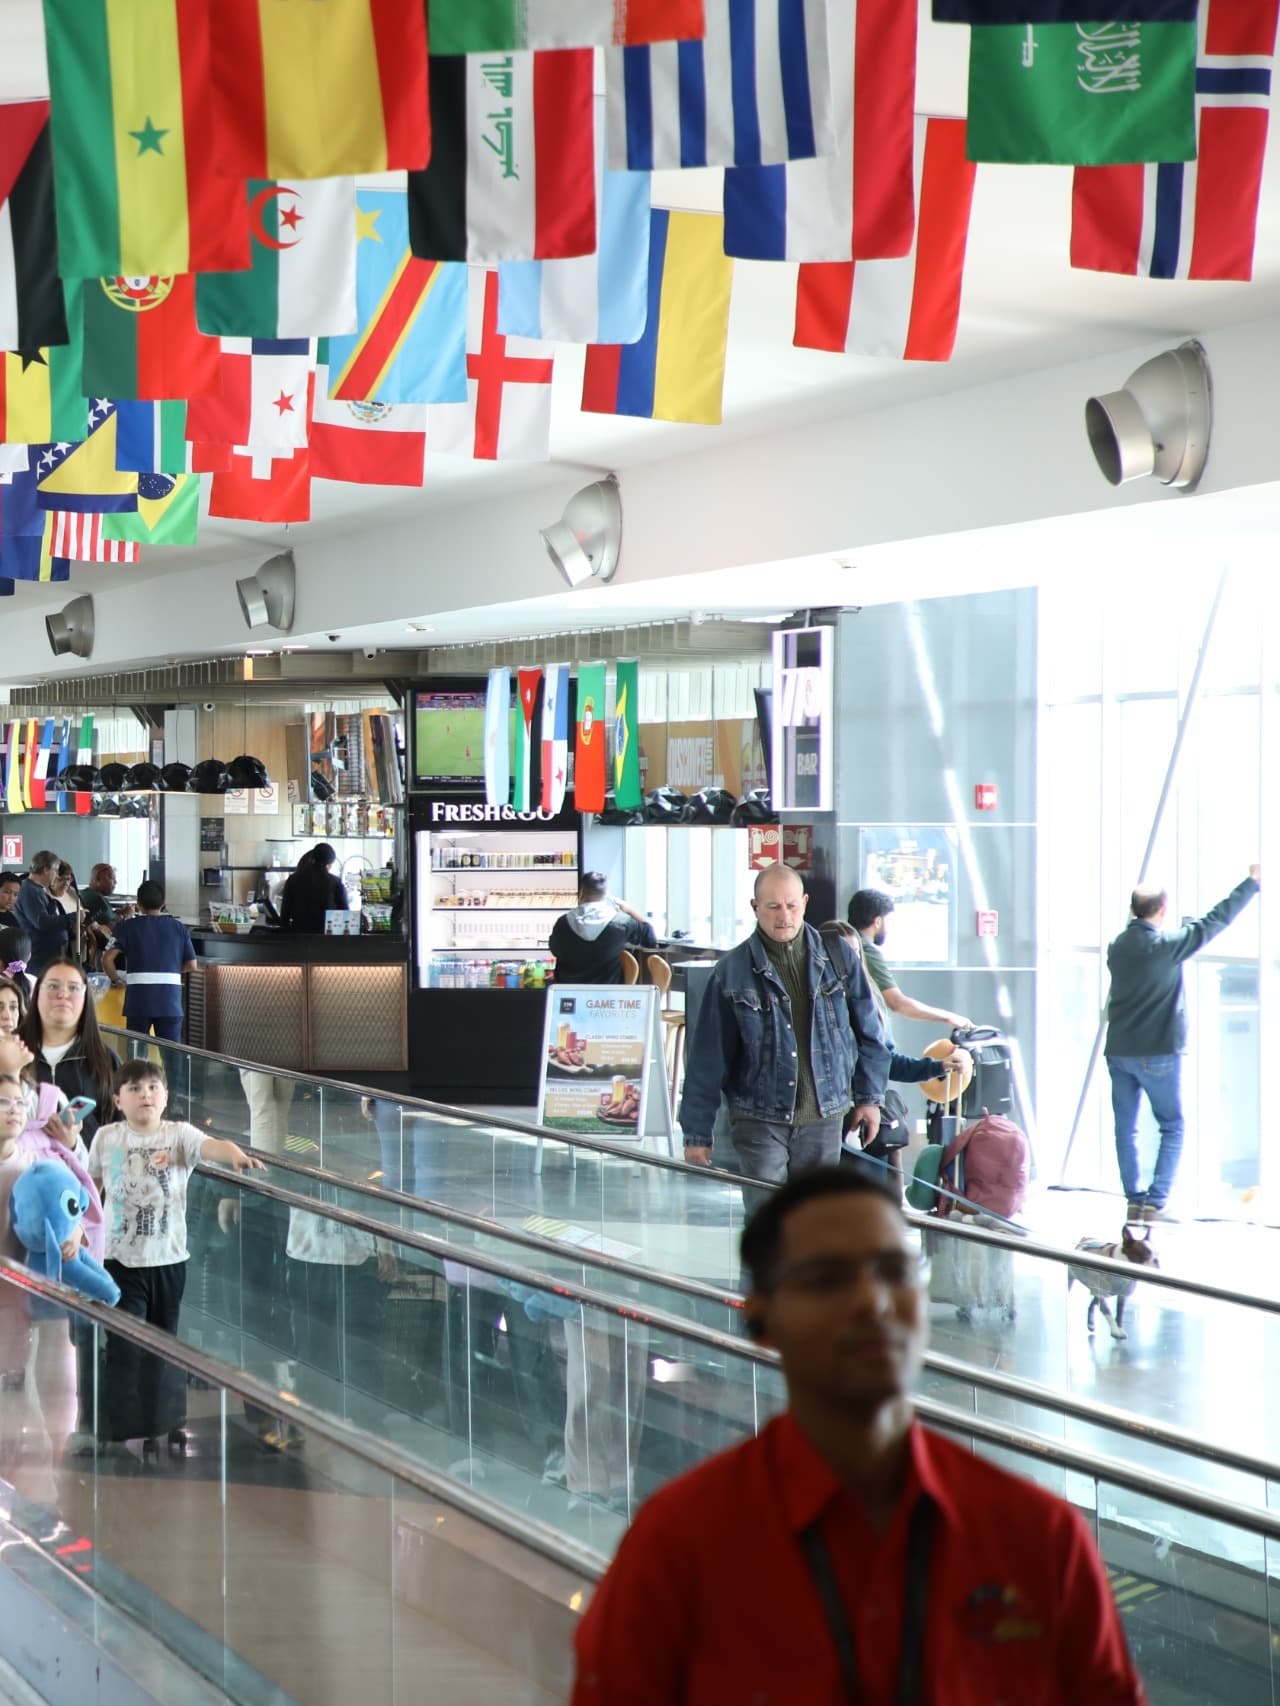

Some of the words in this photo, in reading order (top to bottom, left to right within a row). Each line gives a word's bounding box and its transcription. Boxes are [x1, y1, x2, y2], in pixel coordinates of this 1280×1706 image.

[797, 753, 818, 776] BAR
[585, 999, 616, 1009] GAME
[618, 999, 642, 1009] TIME
